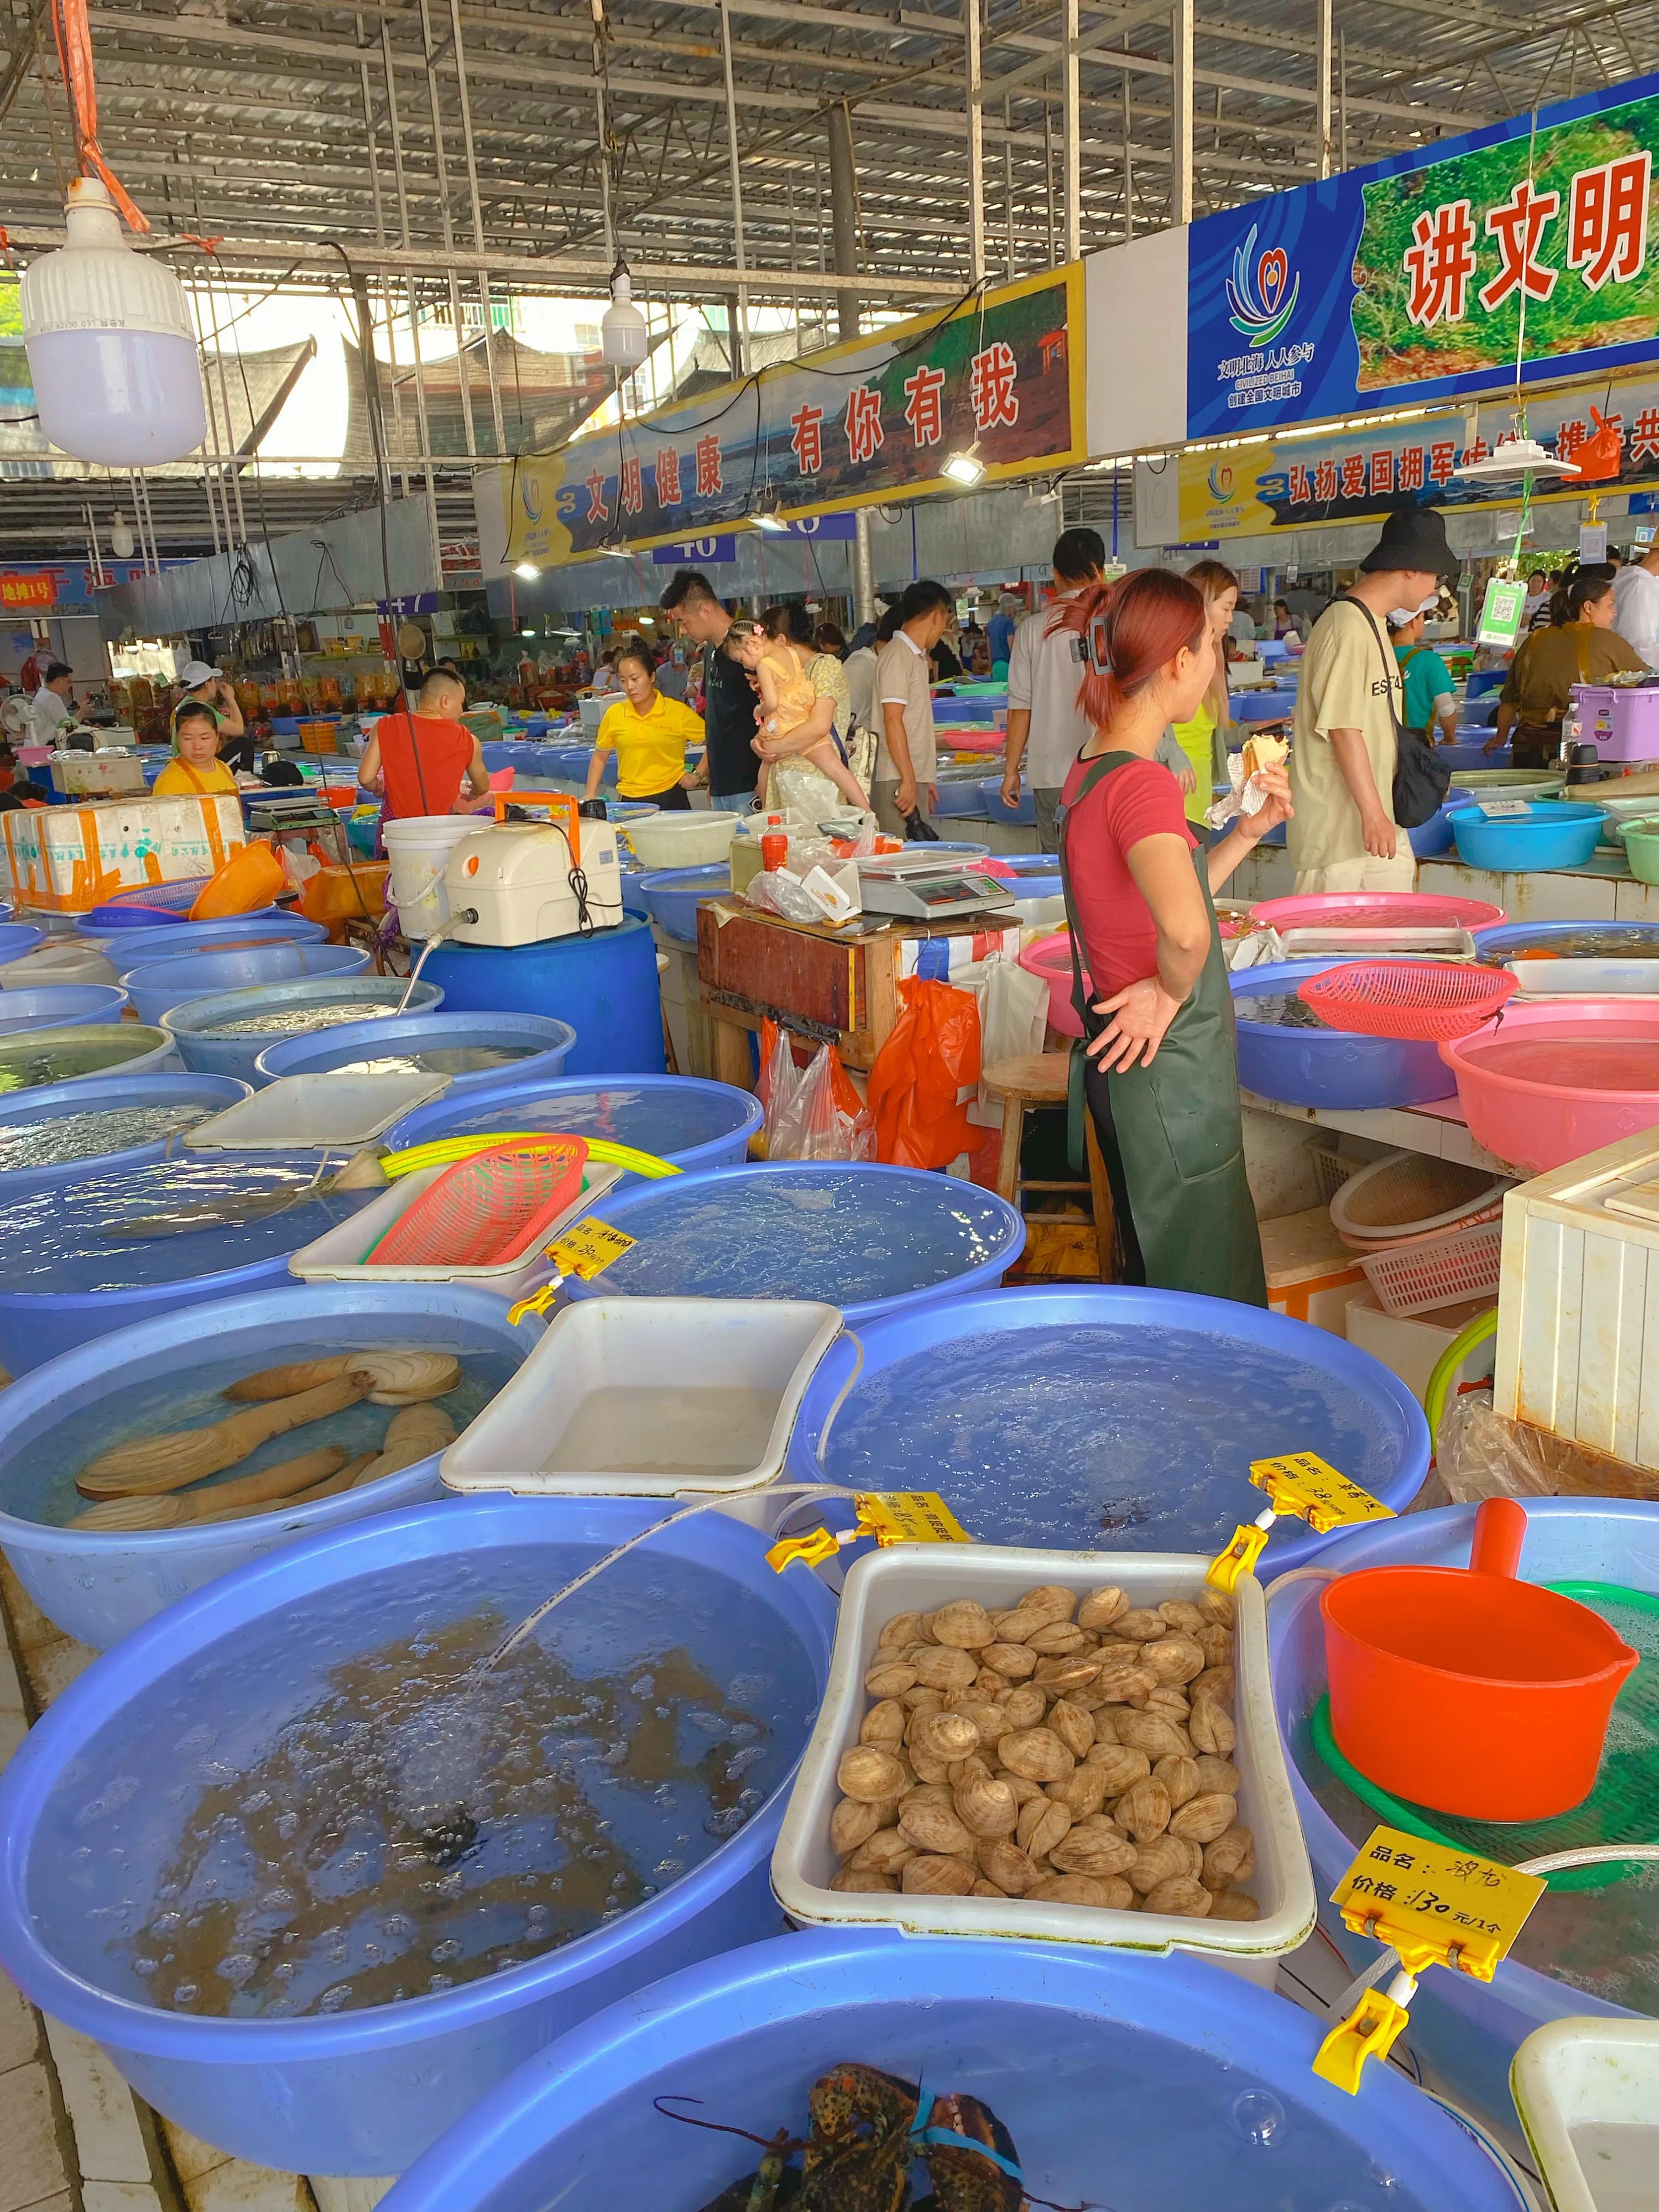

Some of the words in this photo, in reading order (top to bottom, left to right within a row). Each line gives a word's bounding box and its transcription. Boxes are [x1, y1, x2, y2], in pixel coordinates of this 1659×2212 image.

[1404, 151, 1651, 327] 讲文明
[585, 434, 723, 524] 文明健康
[790, 341, 1019, 474] 有你有我
[1288, 431, 1520, 504] 弘扬爱国拥军传
[2, 582, 49, 601] 地摊1号
